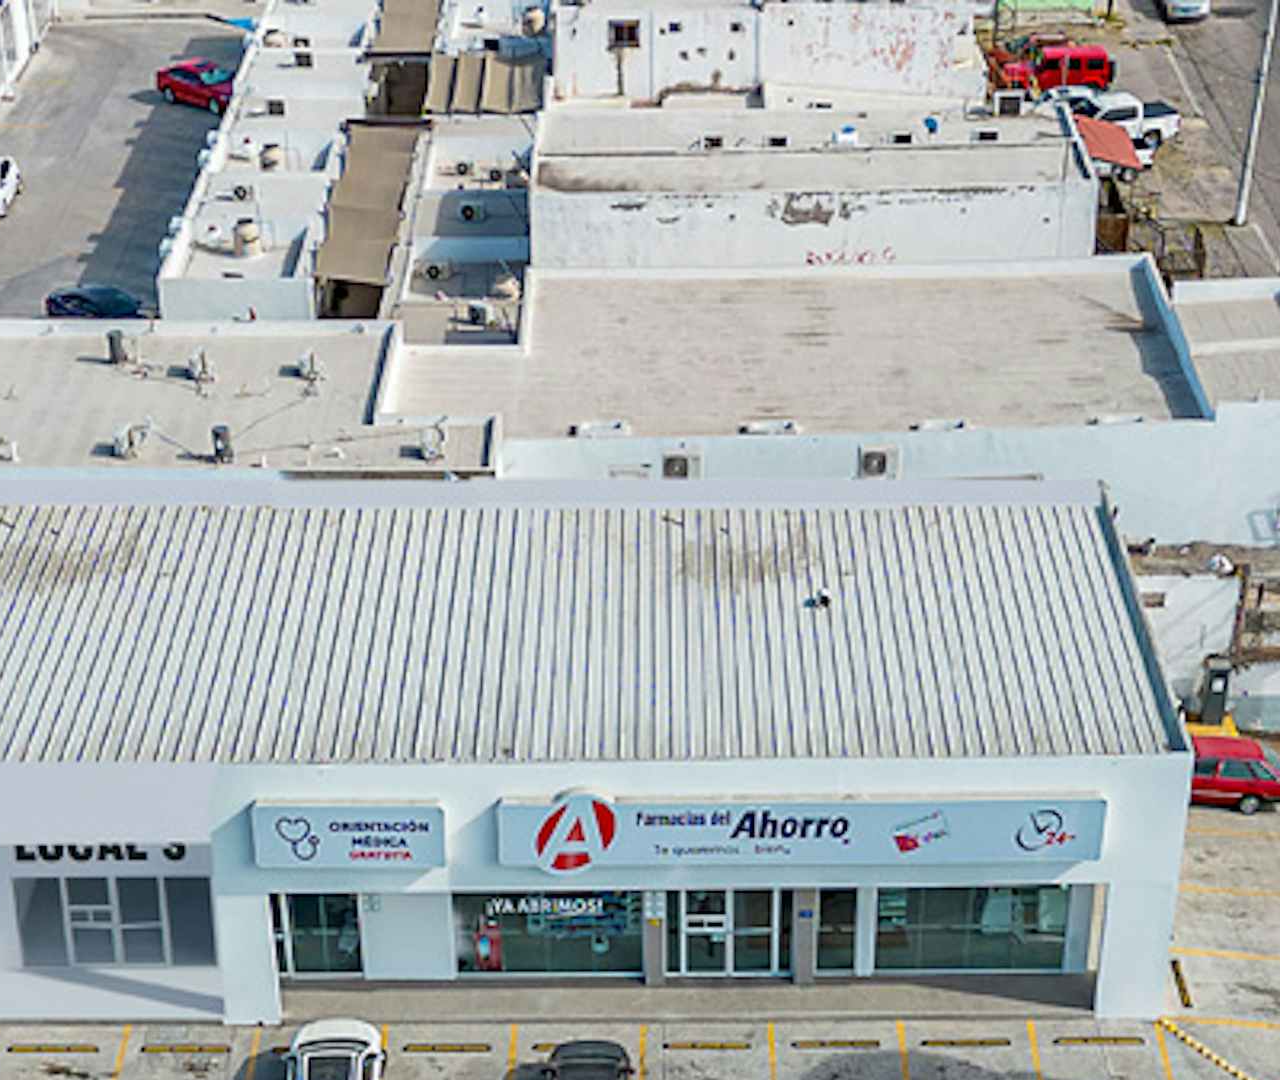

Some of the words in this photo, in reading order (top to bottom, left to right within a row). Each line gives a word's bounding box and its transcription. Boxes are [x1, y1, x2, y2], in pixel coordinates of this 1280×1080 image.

[329, 820, 429, 832] ORIENTACIÓN
[636, 811, 705, 827] Farmacias
[711, 810, 731, 826] del
[731, 810, 849, 839] Ahorro
